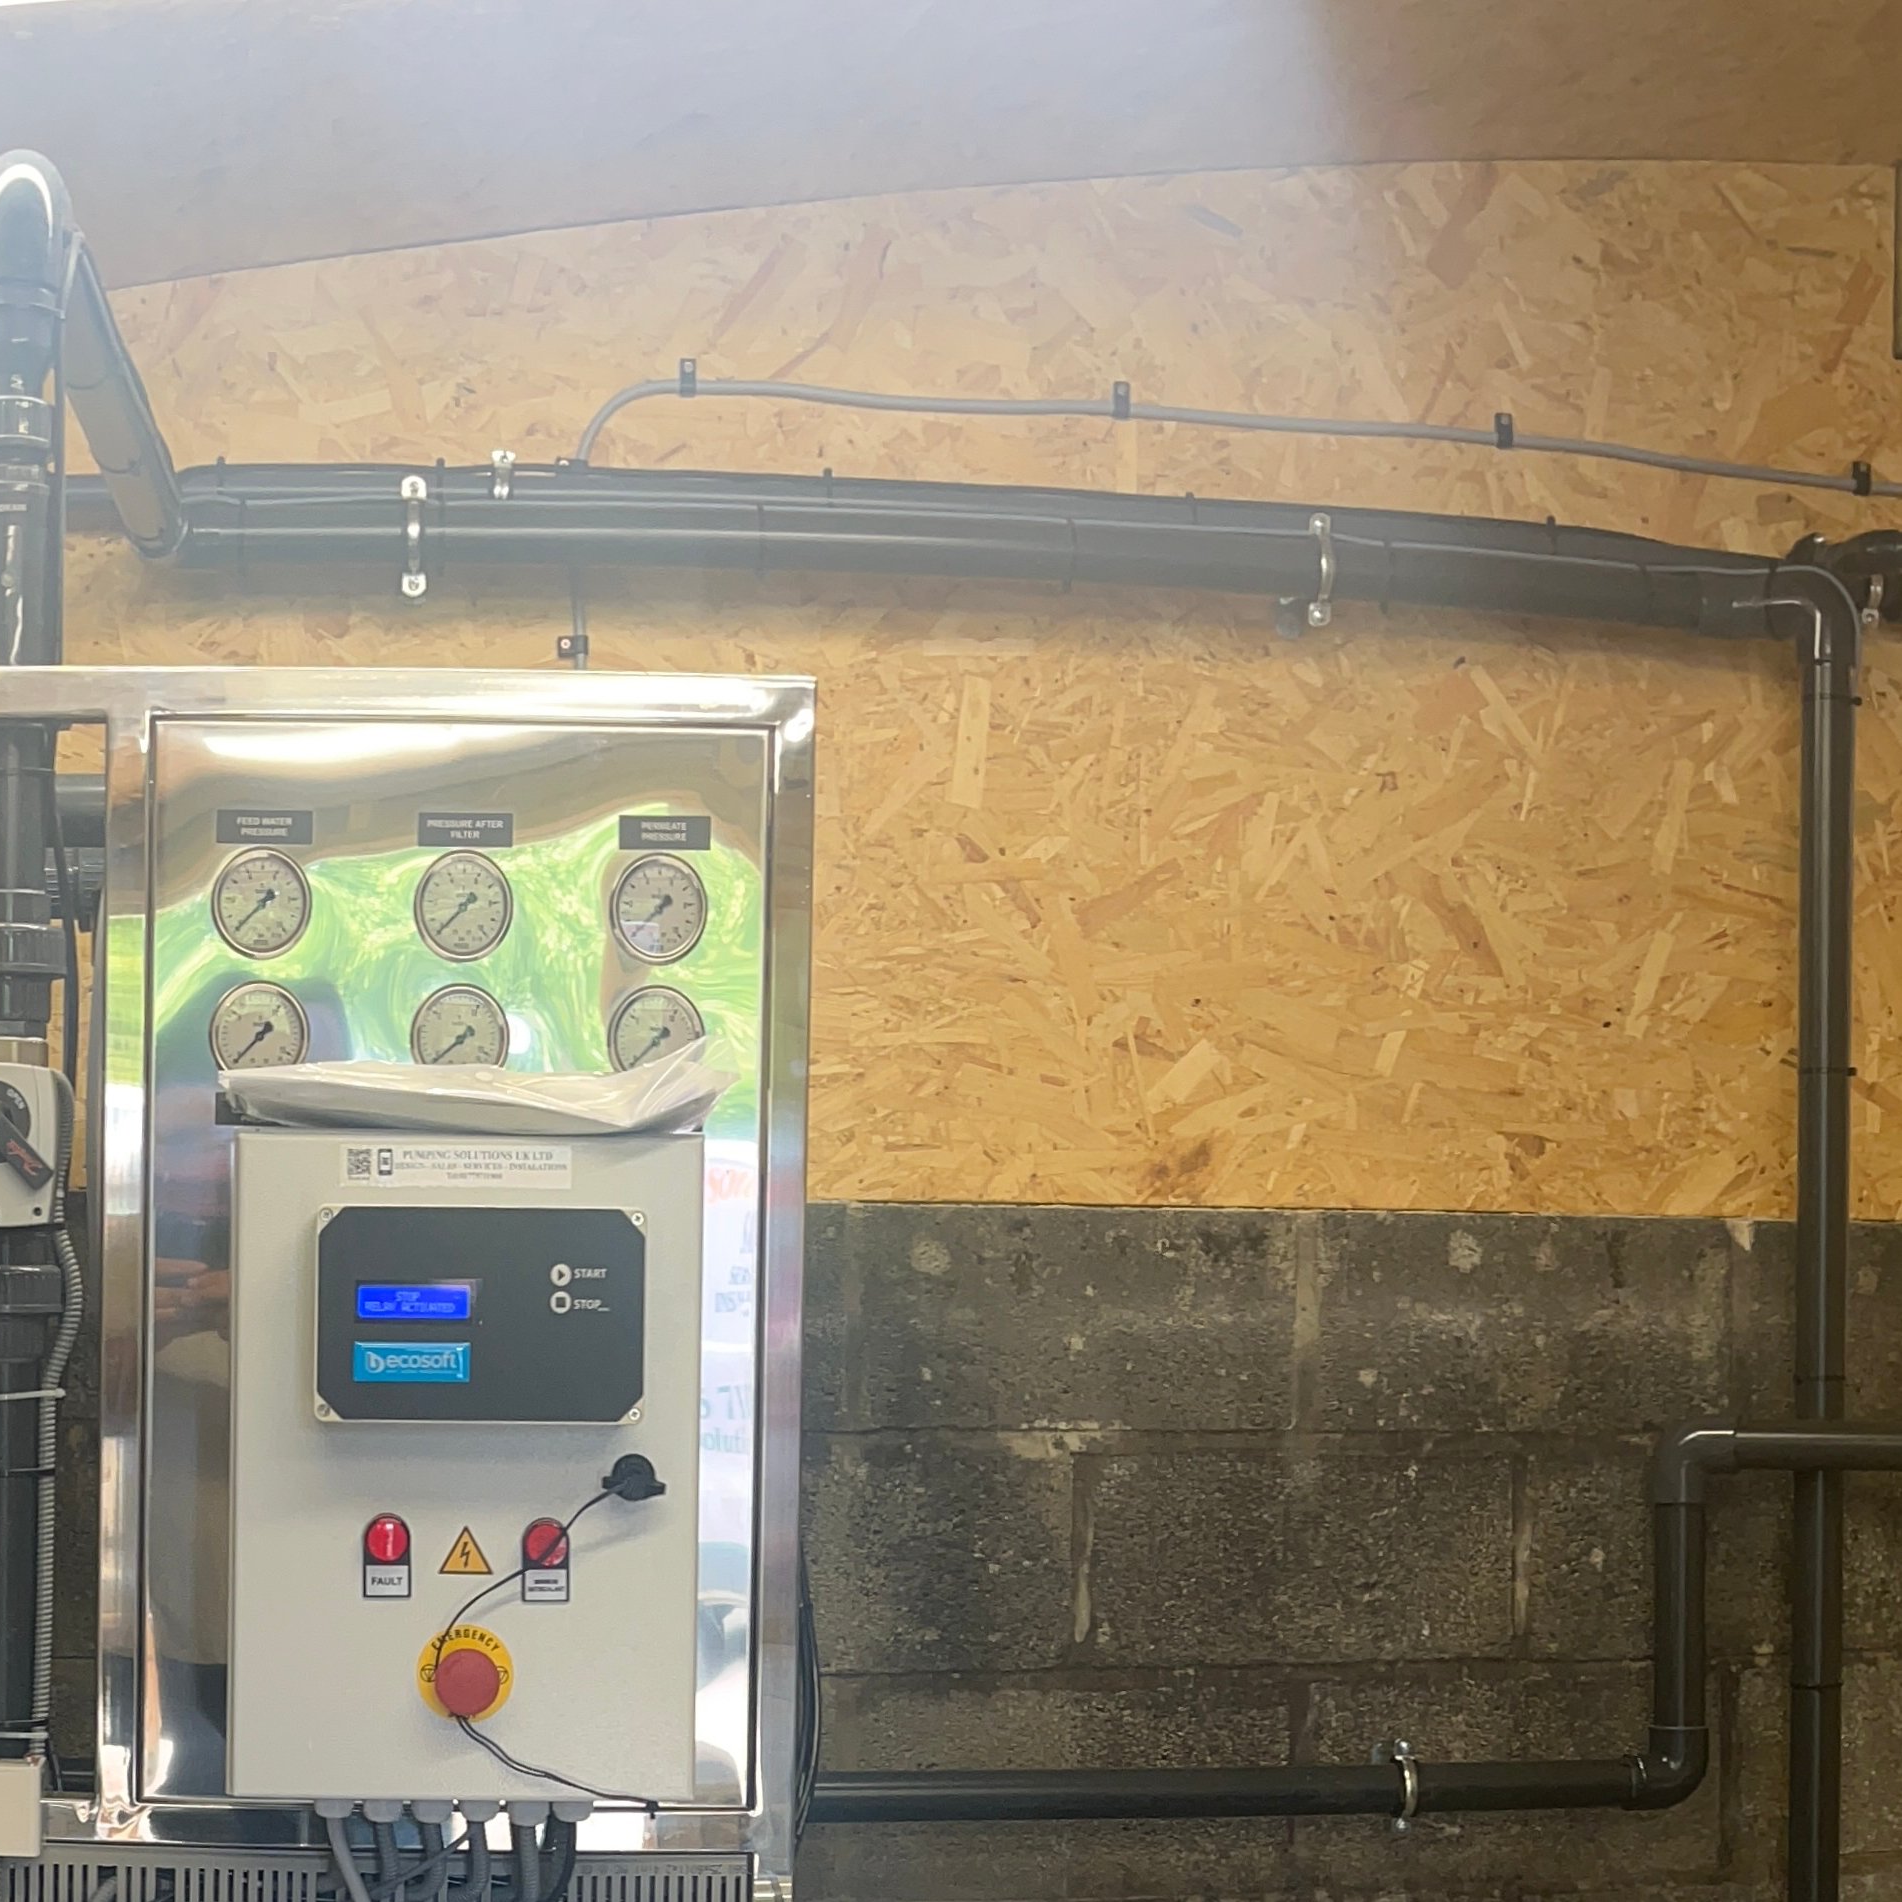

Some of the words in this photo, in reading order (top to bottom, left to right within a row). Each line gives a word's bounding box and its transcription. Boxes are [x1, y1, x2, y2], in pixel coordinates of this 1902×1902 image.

[236, 816, 260, 826] FEED
[261, 817, 293, 826] WATER
[426, 819, 474, 829] PRESSURE
[474, 819, 504, 829] AFTER
[241, 827, 288, 837] PRESSURE
[449, 829, 480, 840] FILTER
[641, 832, 687, 841] PRESSURE
[402, 1150, 451, 1161] PUMPING
[453, 1150, 513, 1161] SOLUTIONS
[532, 1151, 554, 1161] LTD
[573, 1268, 608, 1279] START
[385, 1351, 458, 1369] ecosoft
[370, 1576, 404, 1586] FAULT
